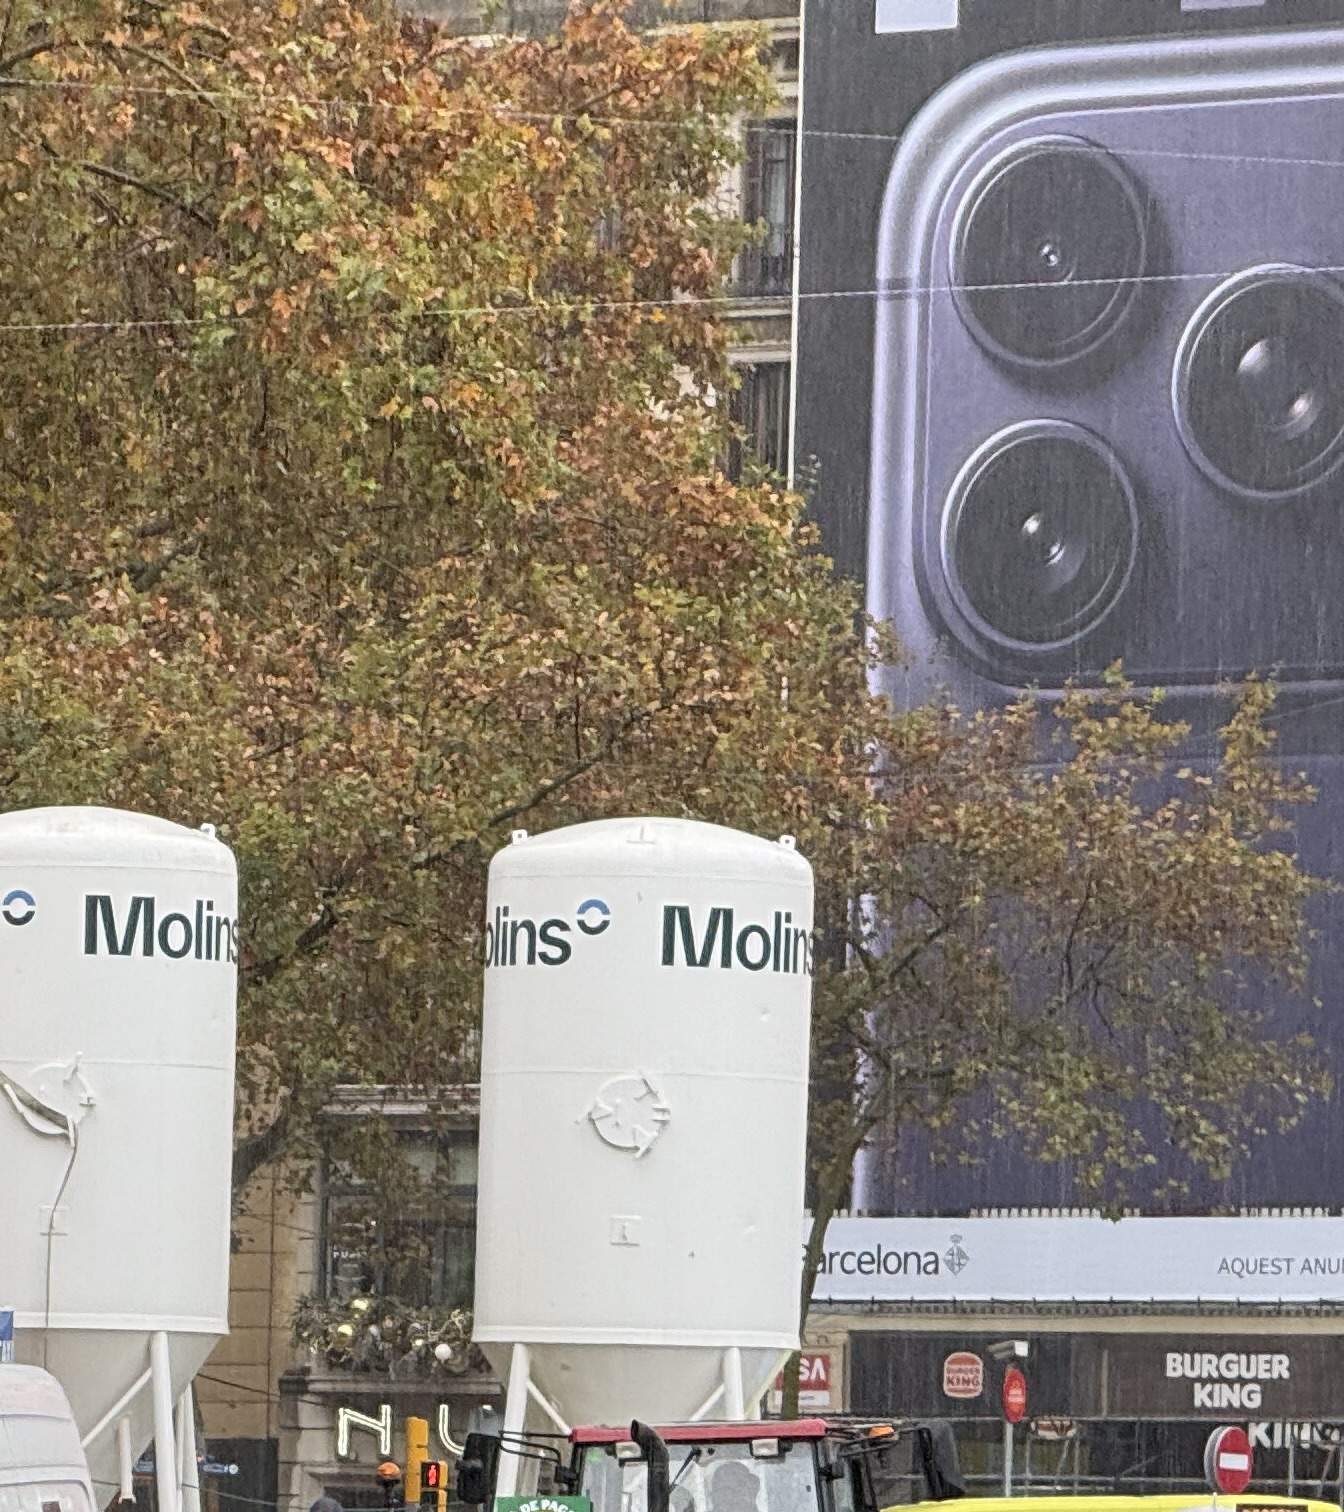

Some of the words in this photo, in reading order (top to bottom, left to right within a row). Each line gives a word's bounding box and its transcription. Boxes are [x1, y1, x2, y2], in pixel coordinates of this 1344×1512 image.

[1217, 1257, 1295, 1279] AQUEST
[1300, 1257, 1344, 1276] ANU
[1166, 1352, 1291, 1380] BURGUER
[1193, 1382, 1262, 1409] KING
